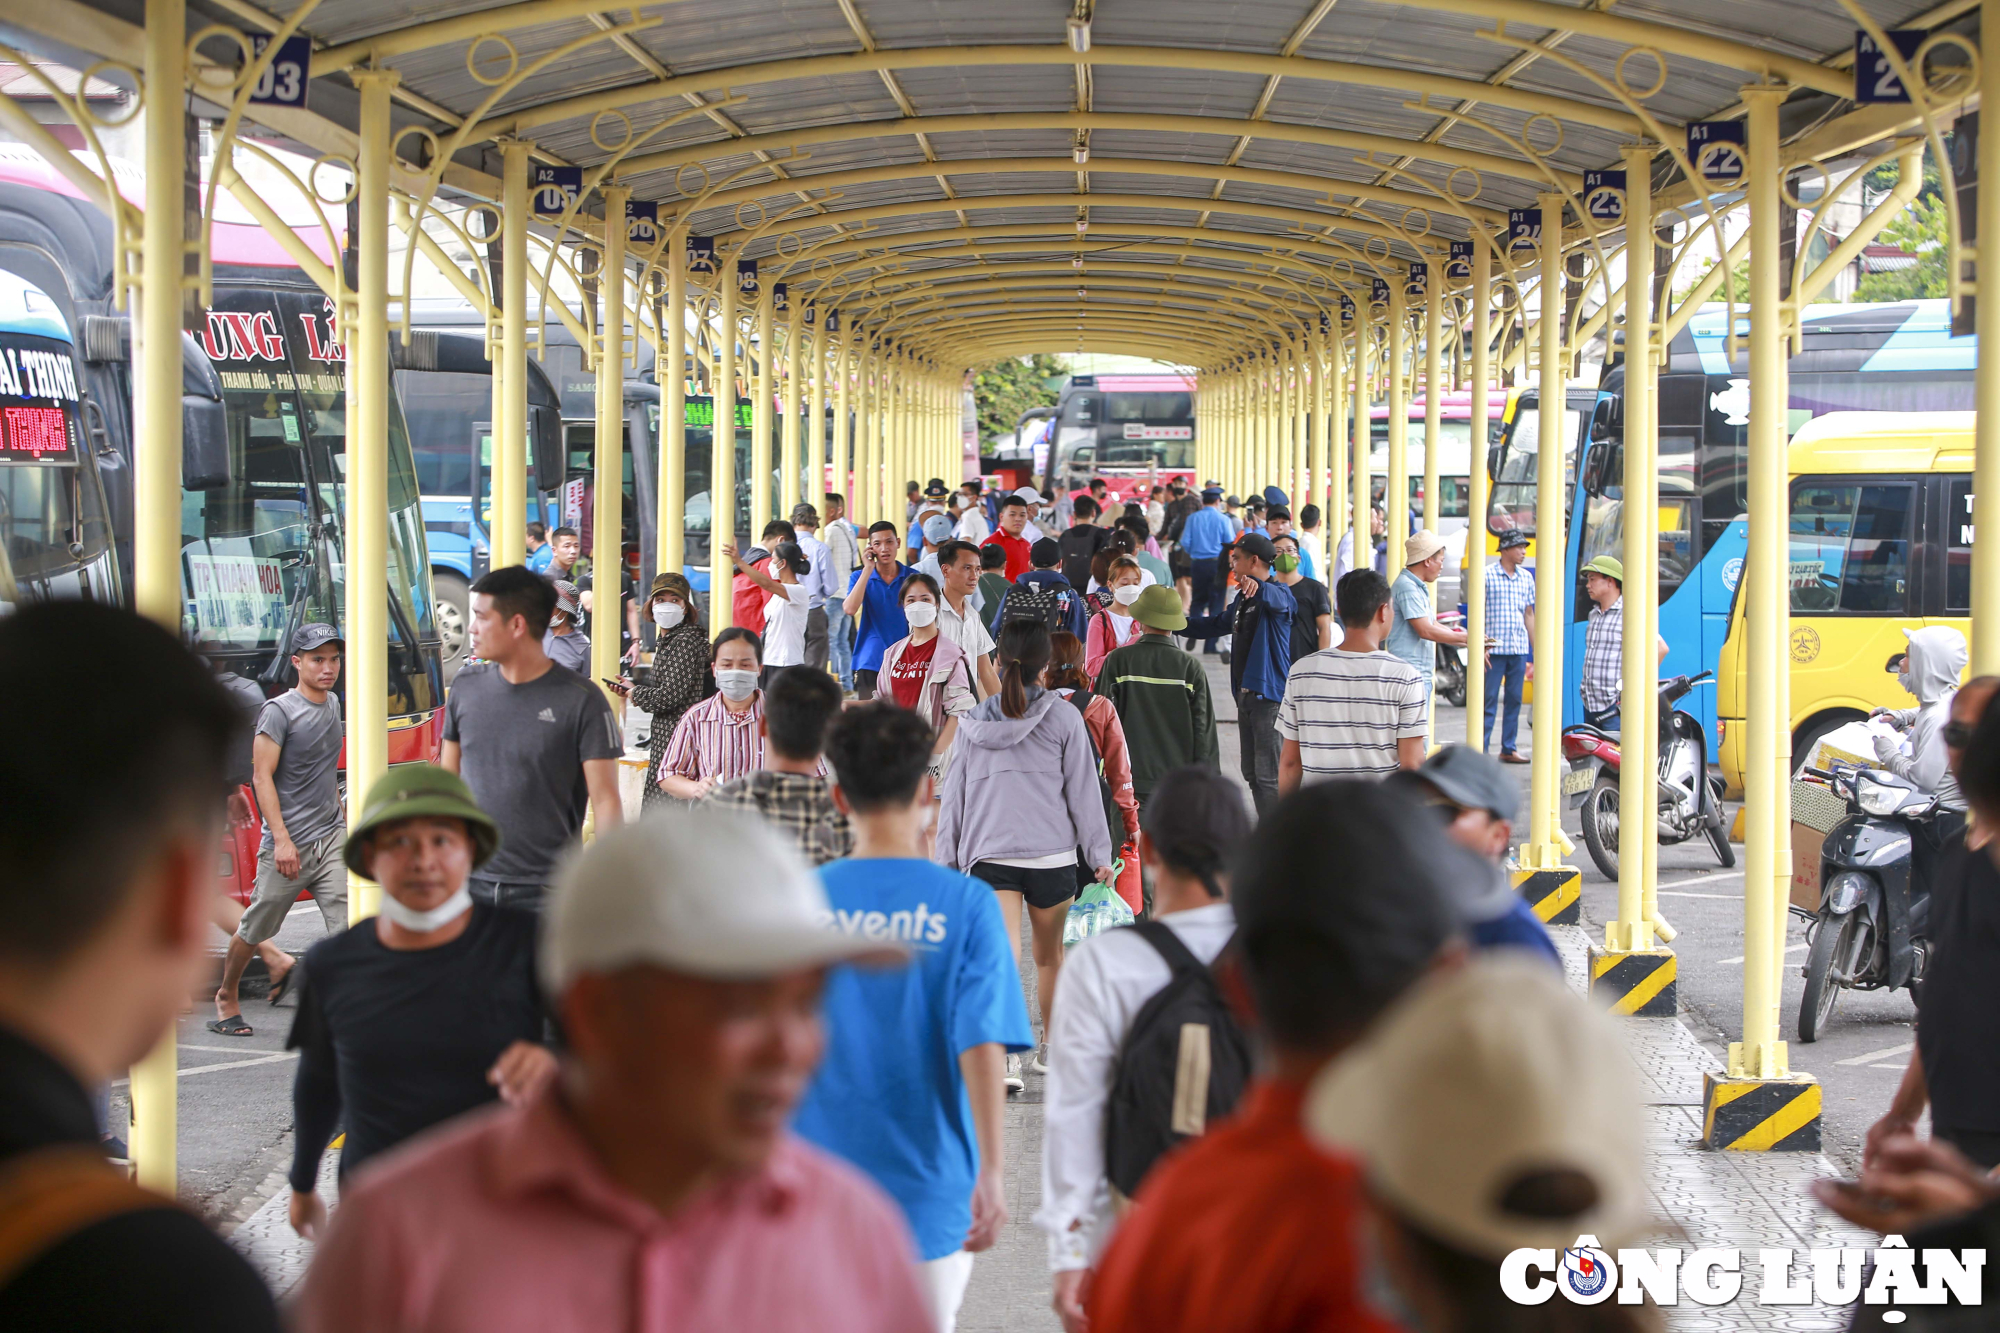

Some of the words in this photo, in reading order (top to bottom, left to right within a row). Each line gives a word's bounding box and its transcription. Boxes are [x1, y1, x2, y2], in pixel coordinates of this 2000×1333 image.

[1873, 57, 1909, 97] 2
[1690, 125, 1709, 140] A1
[1698, 143, 1741, 174] 22
[538, 170, 554, 181] A2
[1586, 173, 1602, 185] A1
[543, 184, 578, 210] 05
[1591, 187, 1626, 215] 23
[1511, 212, 1524, 222] A1
[1452, 244, 1464, 253] A1
[686, 249, 711, 269] 07
[1412, 265, 1422, 273] A1
[1457, 254, 1474, 274] 2
[1415, 274, 1427, 292] 2
[1377, 289, 1391, 304] 2
[194, 305, 285, 362] ÙNG
[0, 348, 24, 396] AI
[20, 349, 79, 408] THỊNH
[220, 371, 252, 390] THANH
[251, 369, 272, 390] HÓA
[1963, 494, 1977, 514] T
[1960, 525, 1977, 544] N
[213, 562, 257, 594] THANH
[257, 560, 283, 595] HÓA
